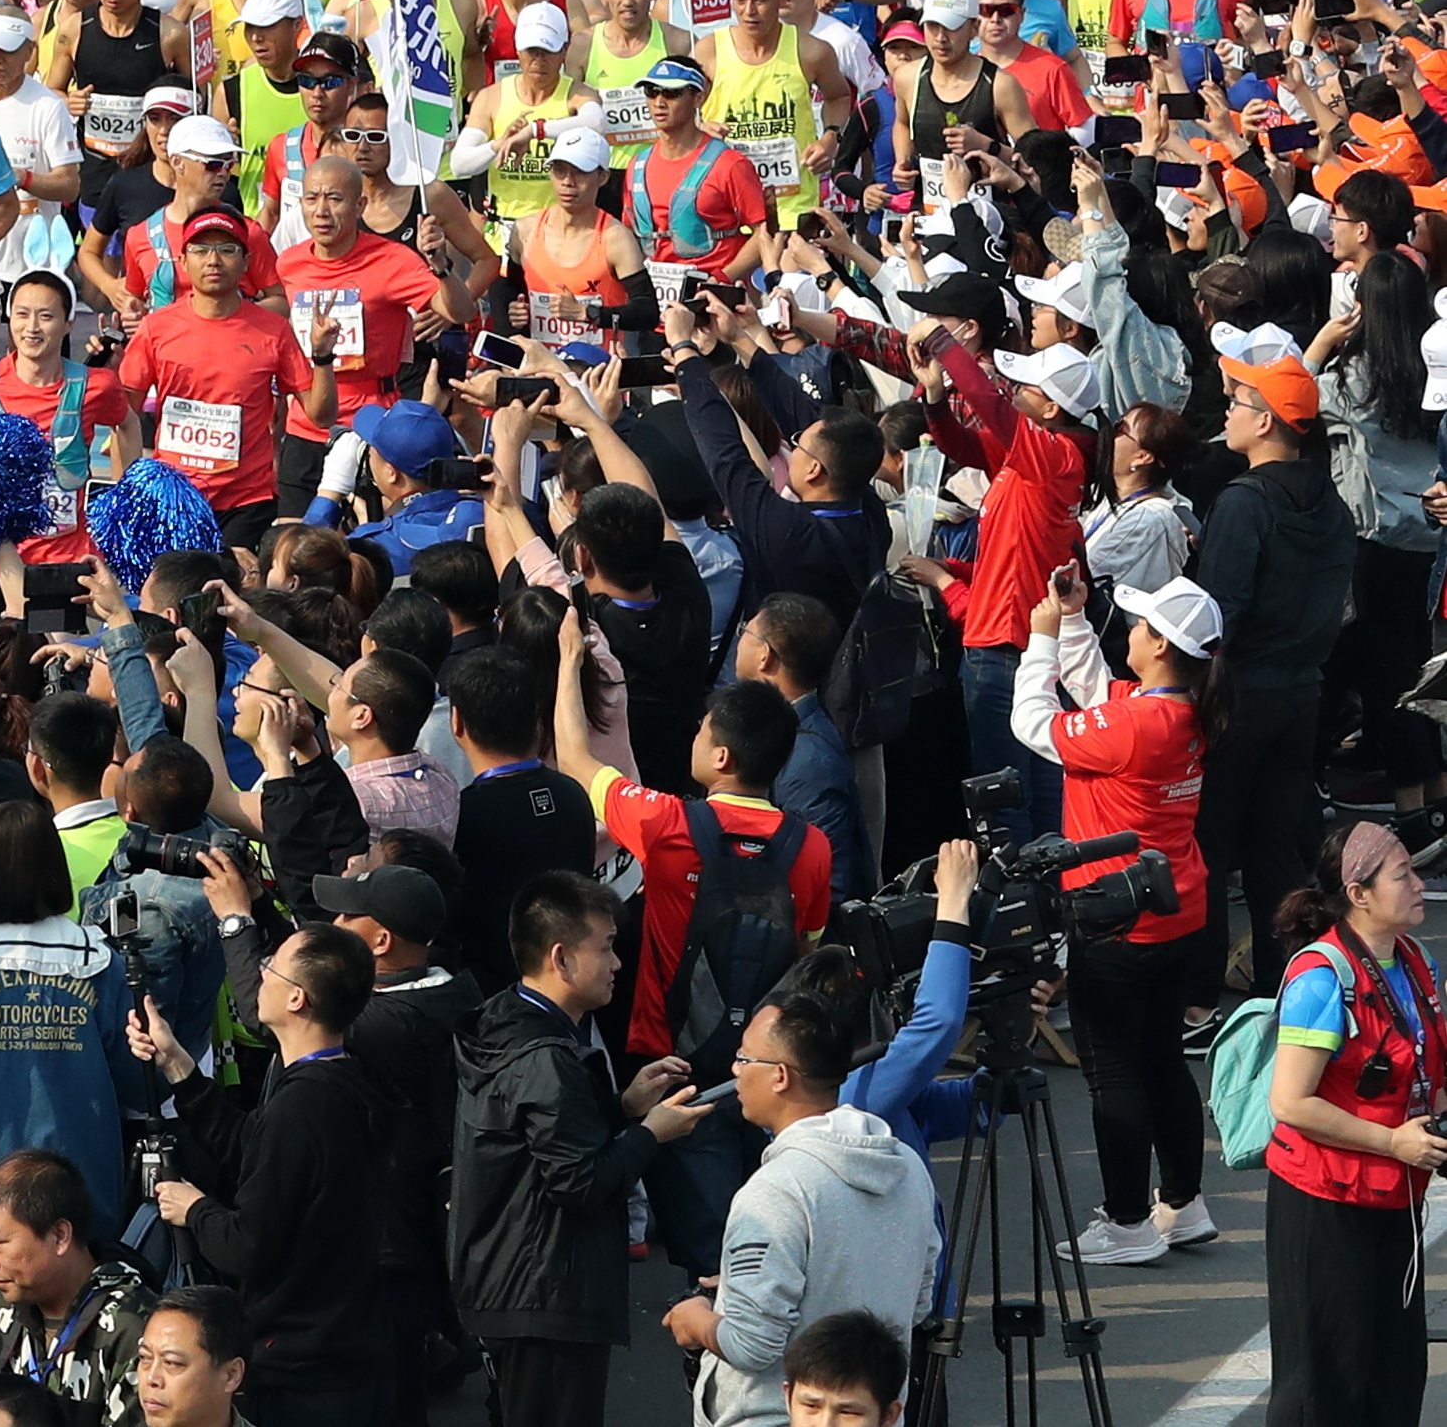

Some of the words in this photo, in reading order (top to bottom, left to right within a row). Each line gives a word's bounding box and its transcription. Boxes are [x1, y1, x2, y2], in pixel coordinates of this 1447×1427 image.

[90, 115, 143, 136] S0241
[167, 424, 237, 447] T0052
[35, 1026, 77, 1040] SERVICE
